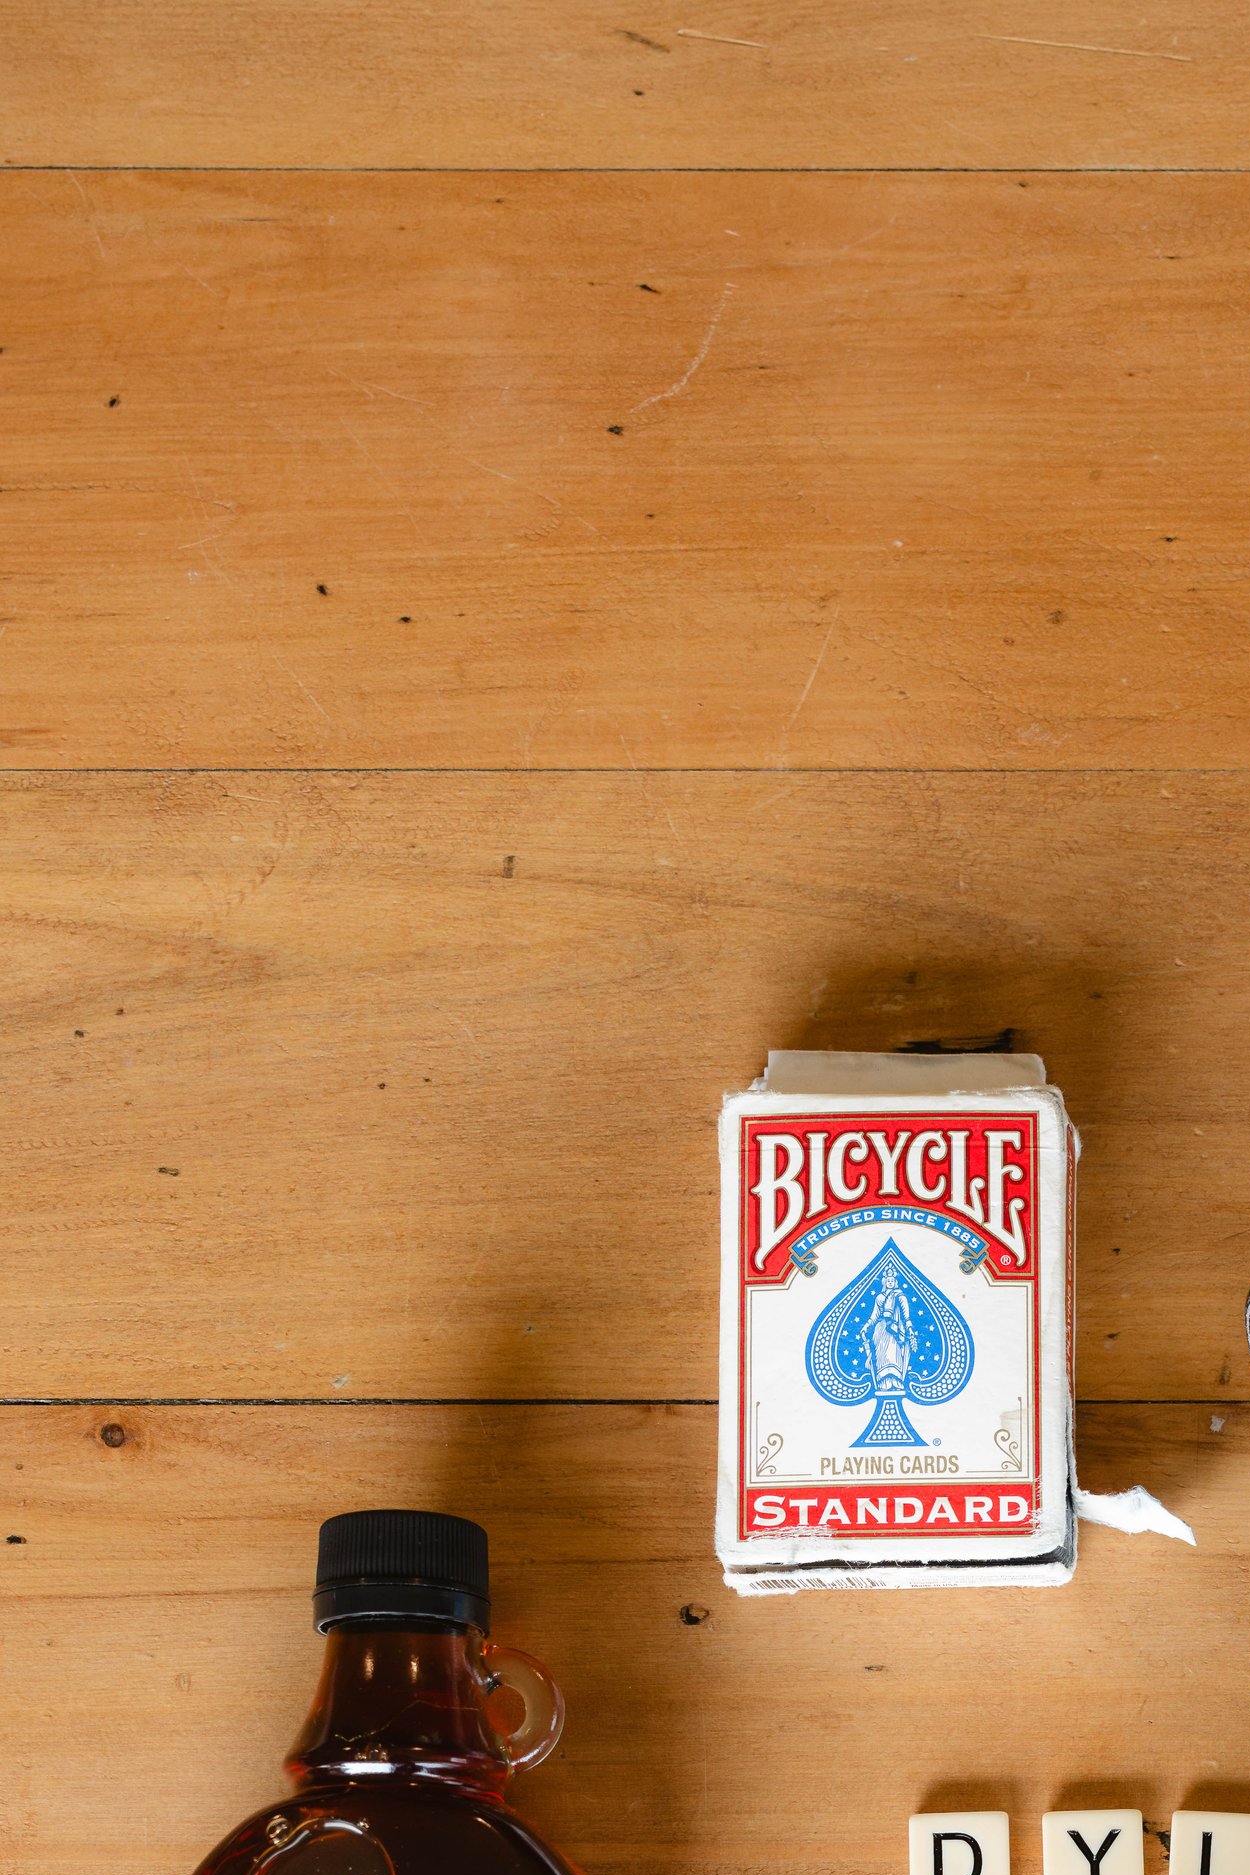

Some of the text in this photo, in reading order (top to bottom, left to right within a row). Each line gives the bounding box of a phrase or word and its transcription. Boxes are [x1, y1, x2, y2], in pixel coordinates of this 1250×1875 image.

[751, 1131, 1026, 1269] BICYCLE
[796, 1209, 981, 1251] TRUSTED SINCE 1885
[820, 1455, 960, 1476] PLAYING CARDS
[752, 1495, 1030, 1527] STANDARD
